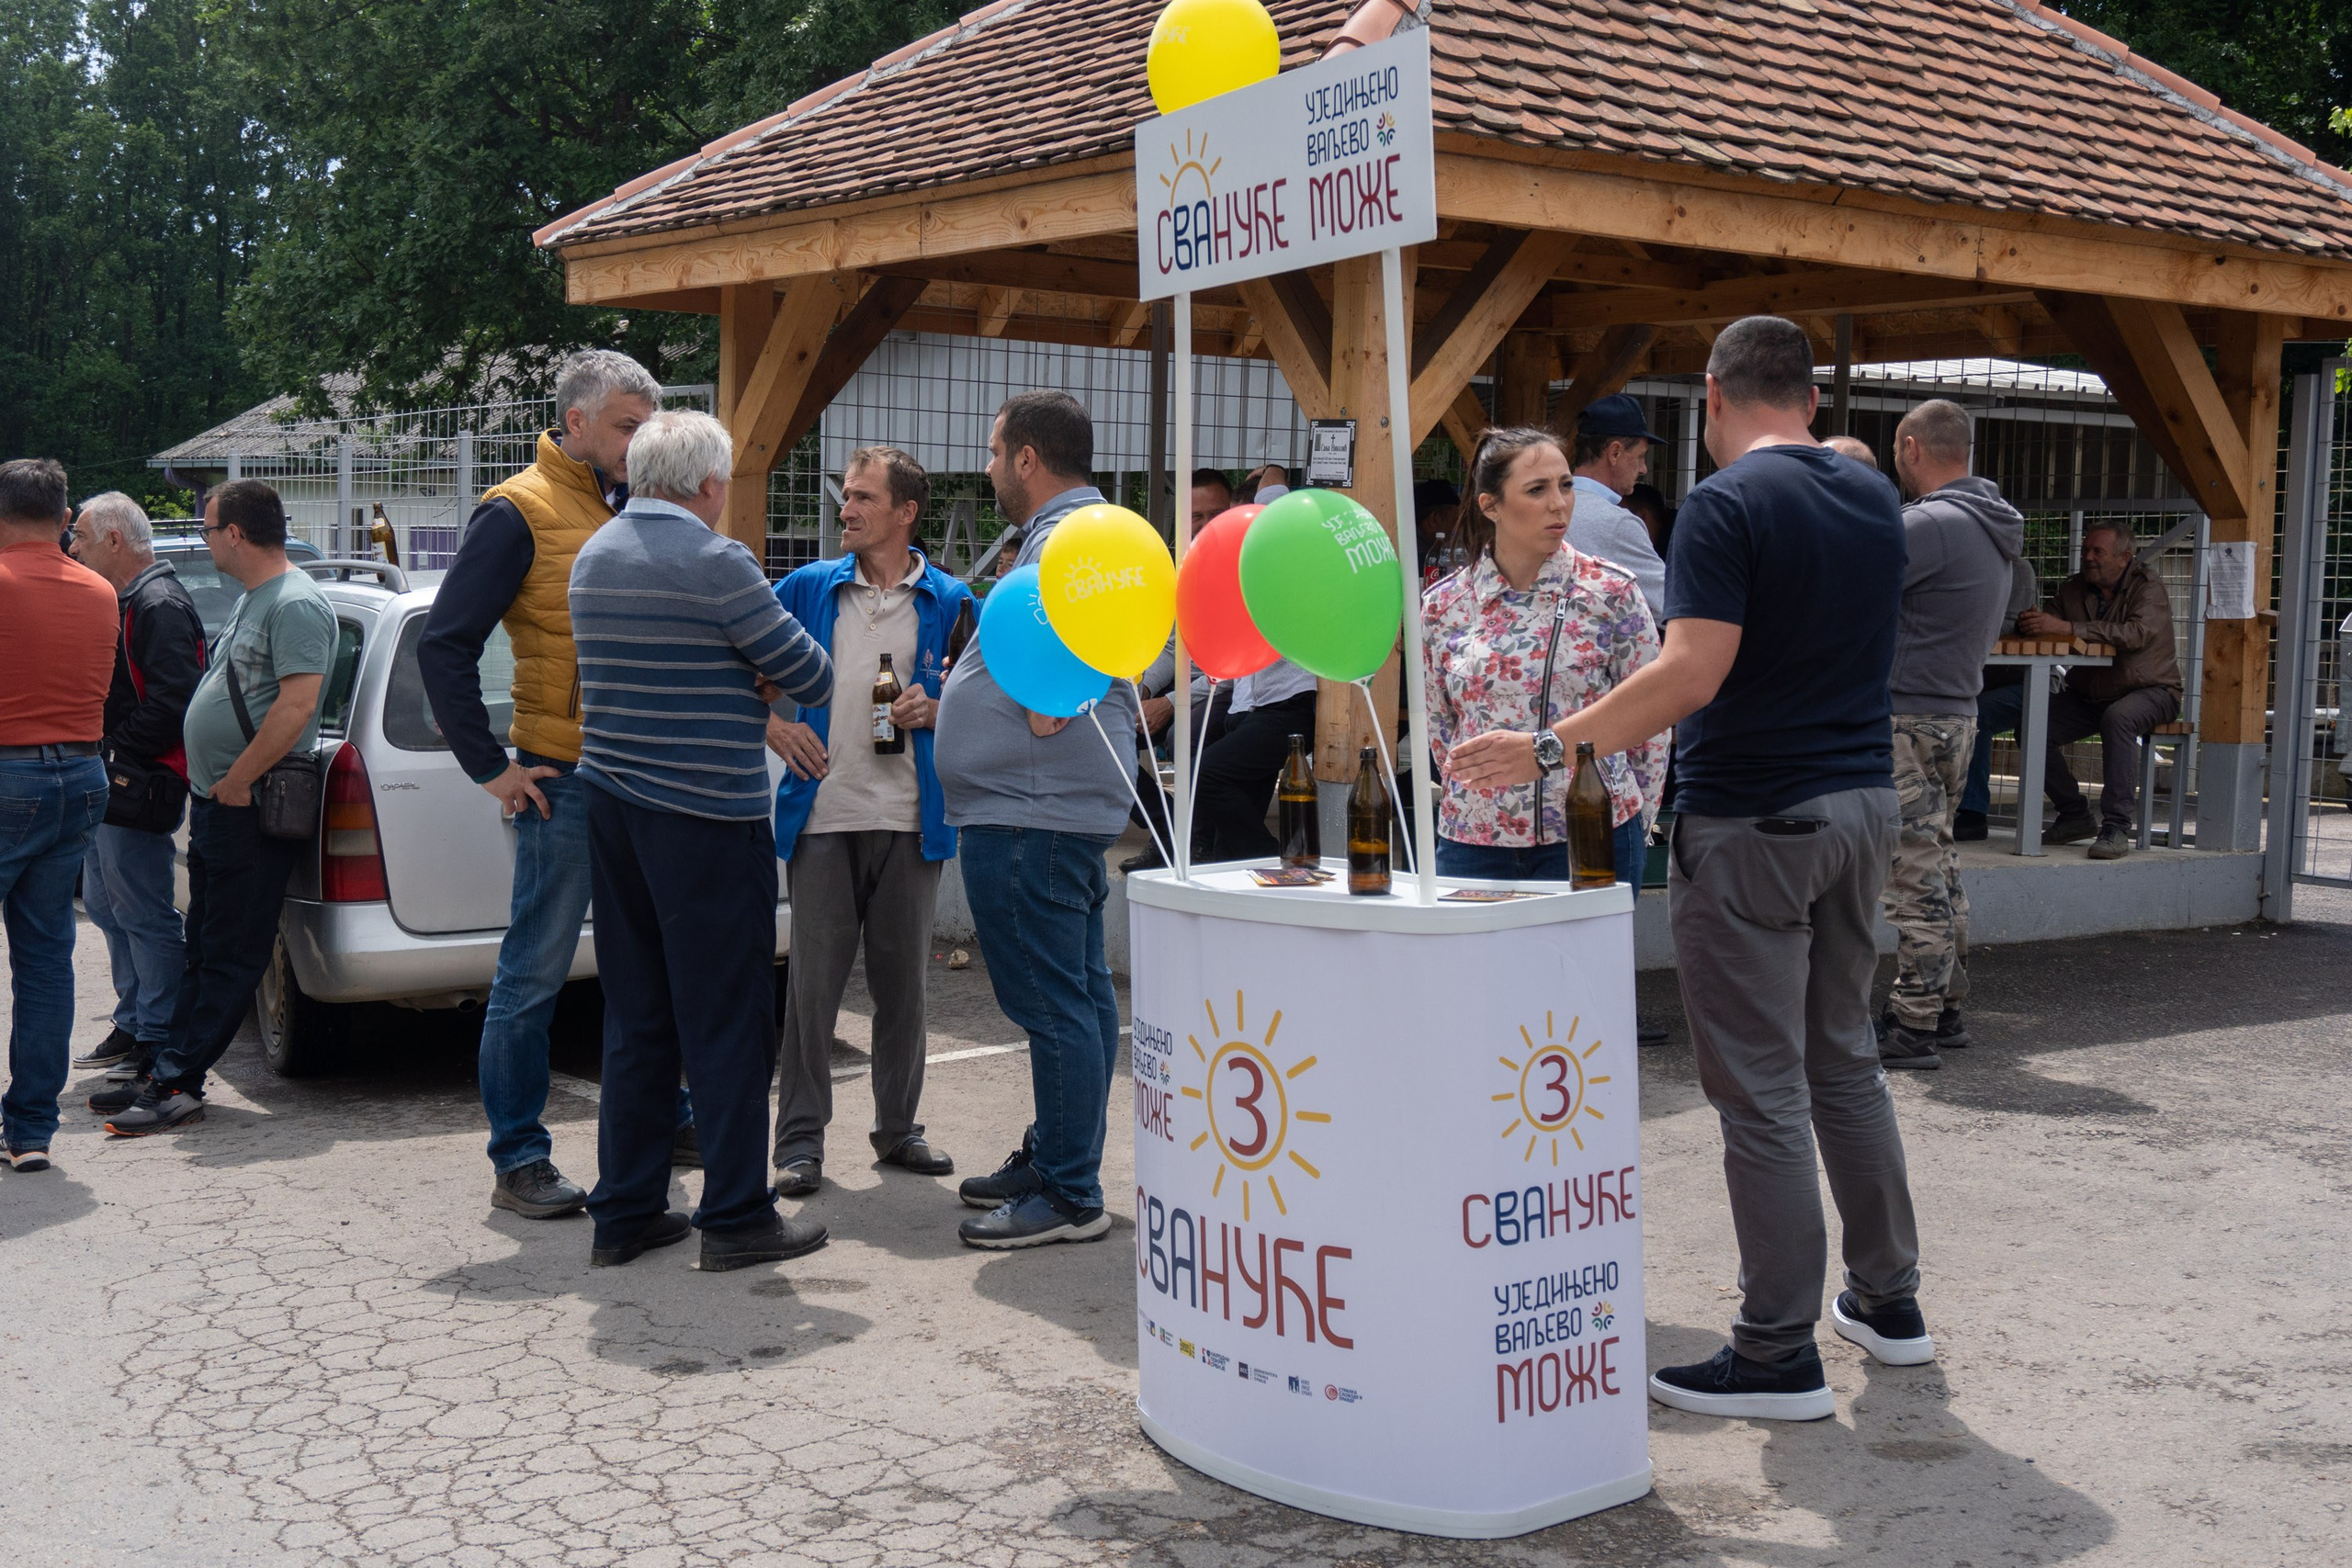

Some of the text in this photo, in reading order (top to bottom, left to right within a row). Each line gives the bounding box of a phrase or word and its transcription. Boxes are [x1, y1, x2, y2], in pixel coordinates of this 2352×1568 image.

[1306, 65, 1398, 125] УЈЕДИЊЕНО
[1306, 118, 1370, 166] ВАЉЕВО
[1157, 153, 1404, 275] СВАНУЋЕ МОЖЕ
[380, 782, 420, 791] OPEL
[1134, 1075, 1174, 1142] МОЖЕ
[1227, 1056, 1268, 1156] 3
[1540, 1055, 1571, 1122] 3
[1463, 1166, 1636, 1249] СВАНУЋЕ
[1136, 1185, 1354, 1350] СВАНУЋЕ
[1494, 1261, 1619, 1316] УЈЕДИЊЕНО
[1496, 1307, 1582, 1355] ВАЉЕВО
[1496, 1337, 1621, 1424] МОЖЕ
